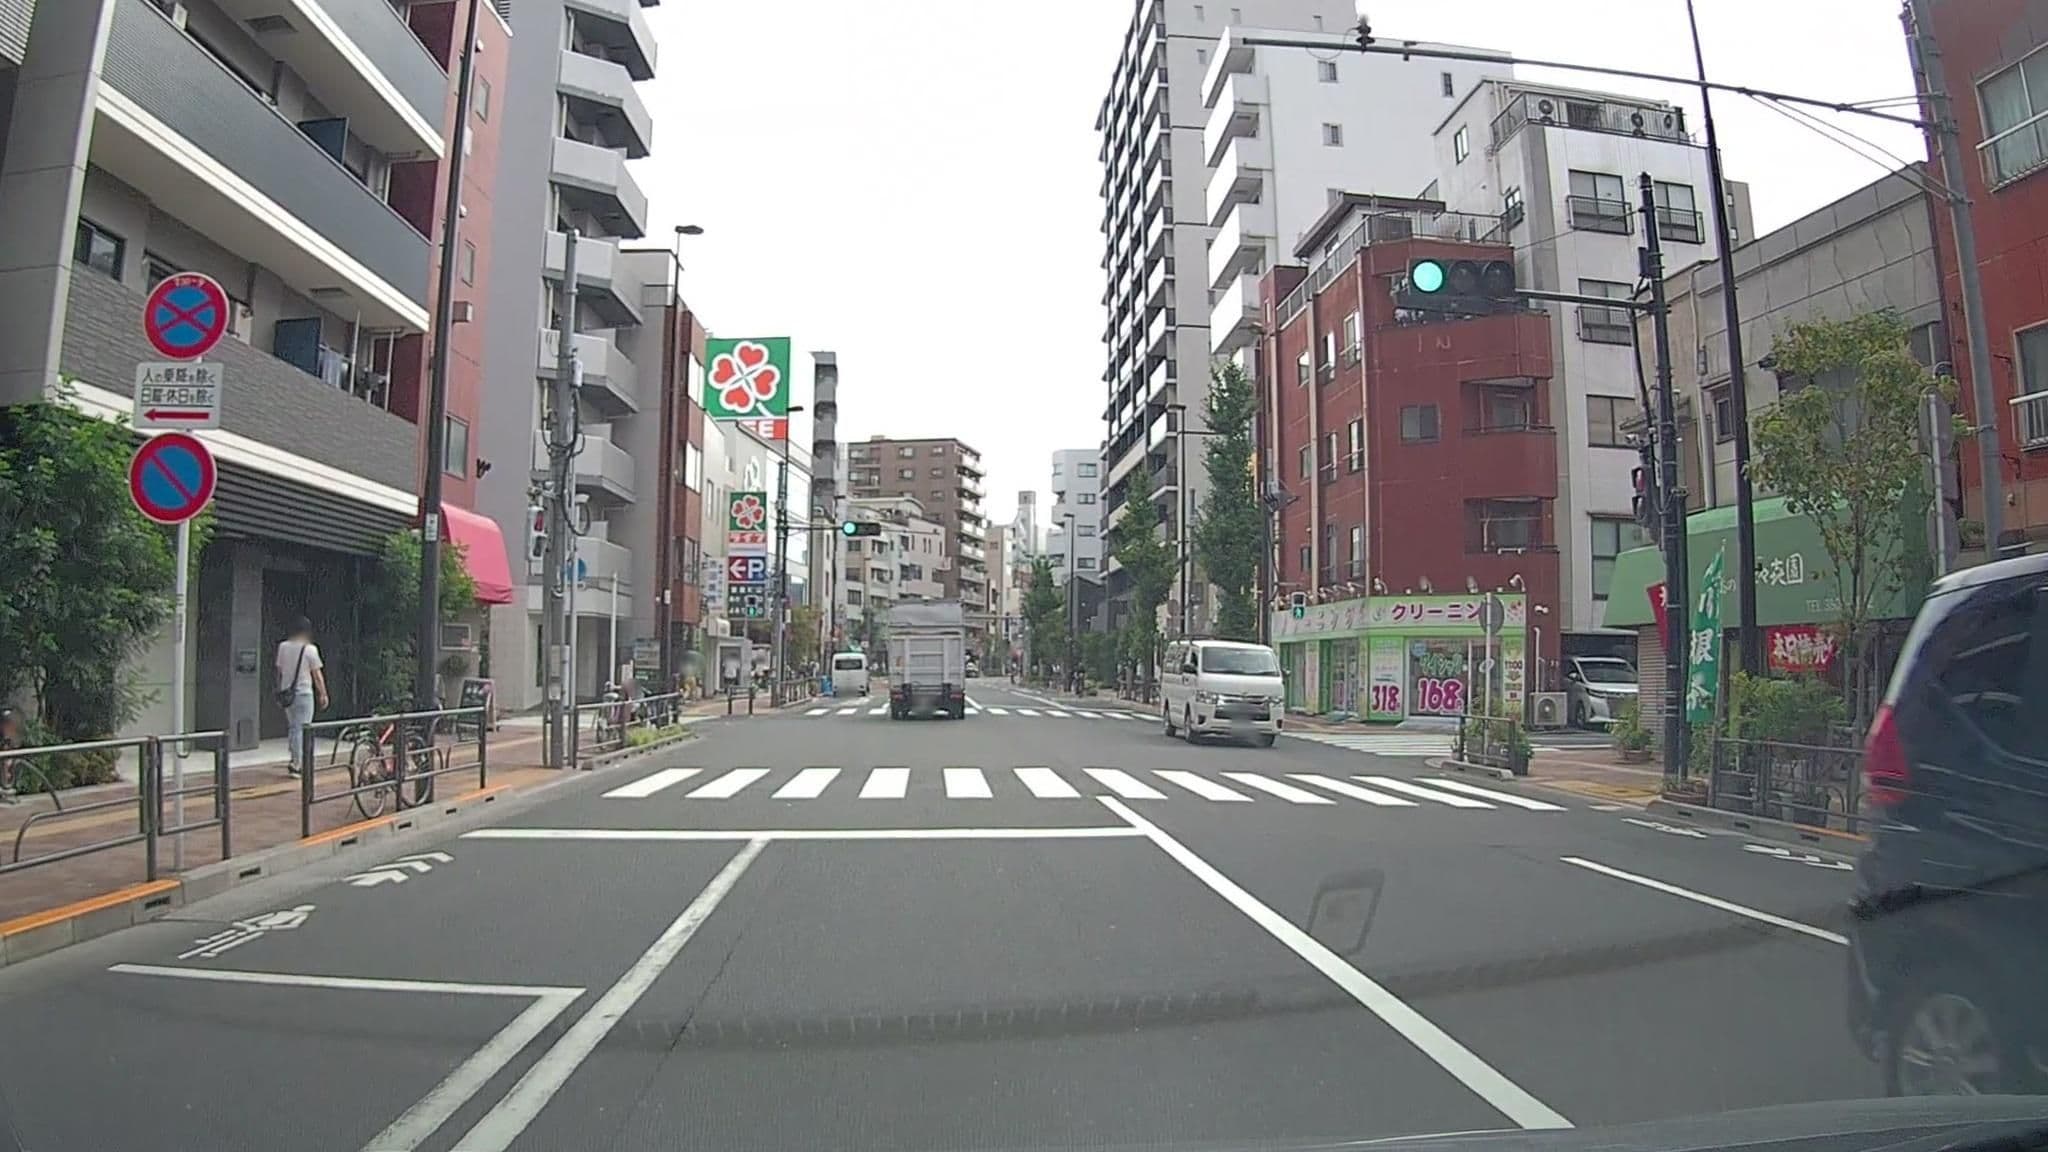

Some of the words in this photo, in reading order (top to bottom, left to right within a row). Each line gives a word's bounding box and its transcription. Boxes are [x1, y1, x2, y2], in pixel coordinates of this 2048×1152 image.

[748, 559, 764, 579] P
[1391, 603, 1480, 621] クリーニン
